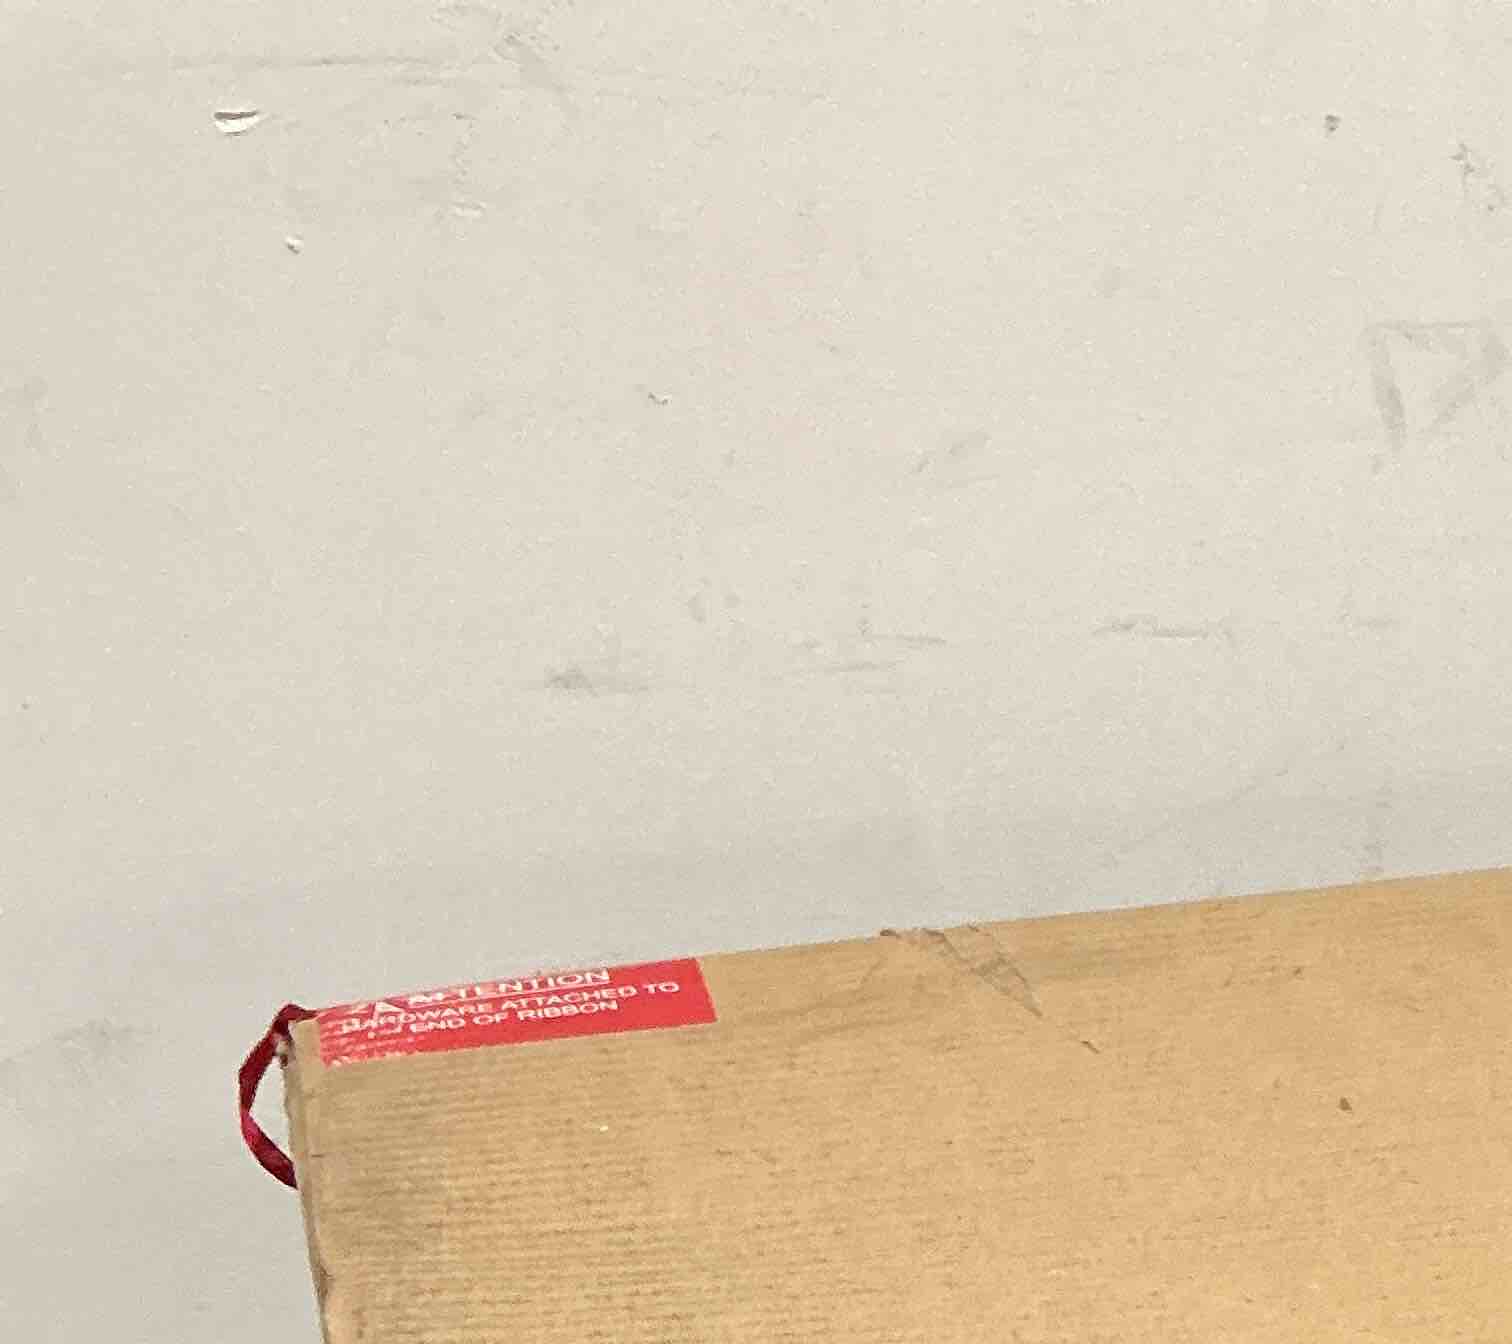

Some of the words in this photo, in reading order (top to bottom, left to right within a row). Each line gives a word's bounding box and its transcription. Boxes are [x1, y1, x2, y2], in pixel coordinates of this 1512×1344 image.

[500, 985, 638, 1011] ATTACHED
[643, 980, 680, 993] TO
[409, 1016, 466, 1033] END
[472, 1011, 508, 1027] OF
[516, 1000, 619, 1022] RIBBON
